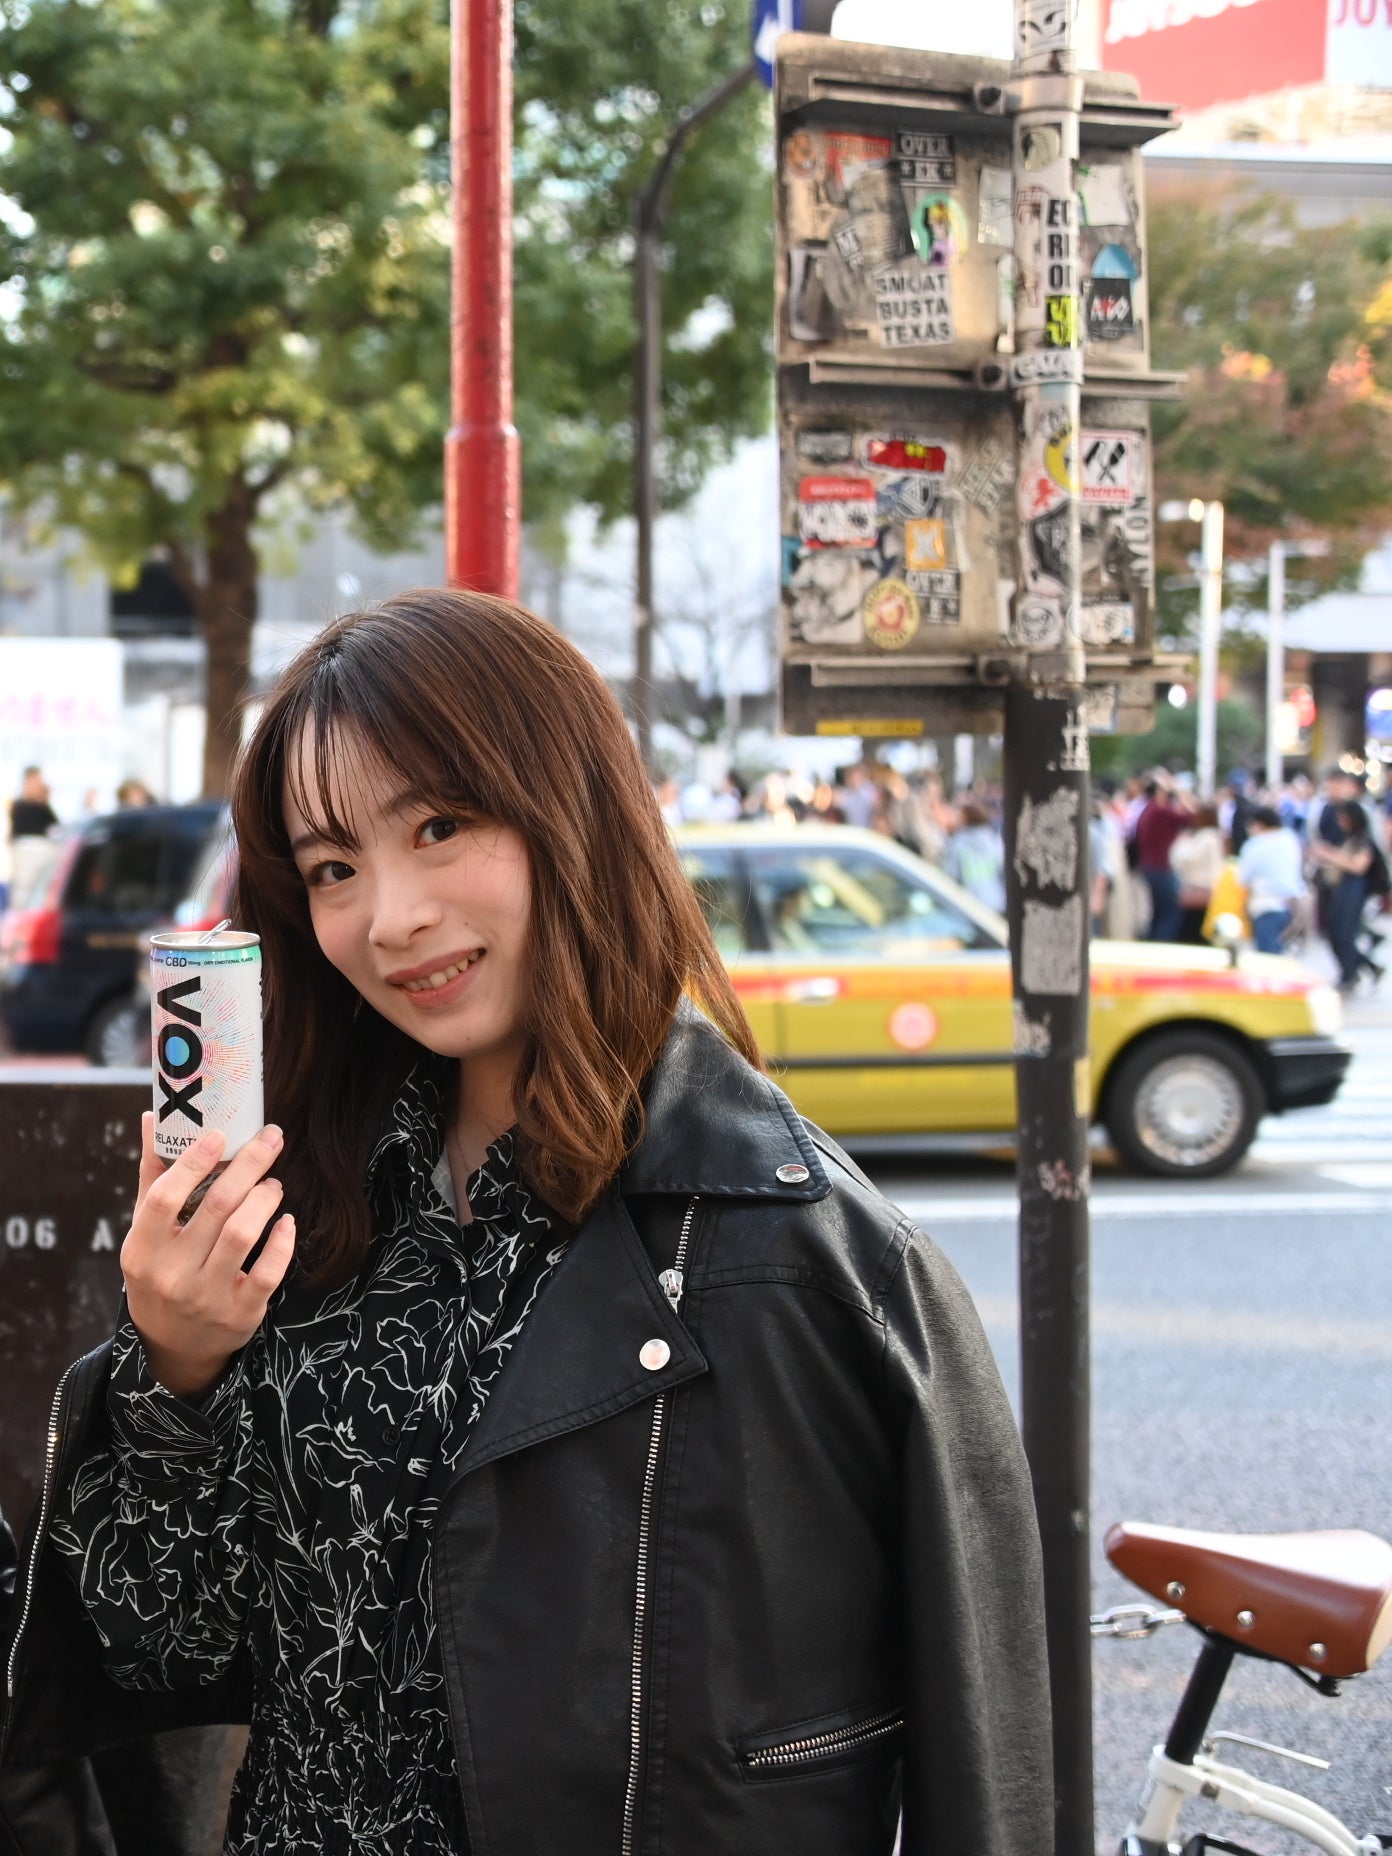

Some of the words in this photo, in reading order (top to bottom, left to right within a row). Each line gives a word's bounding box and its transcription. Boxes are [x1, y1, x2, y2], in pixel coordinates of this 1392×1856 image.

[878, 298, 948, 321] BUSTA
[880, 322, 950, 345] TEXAS
[165, 956, 187, 967] CBD
[156, 975, 204, 1128] VOX
[155, 1131, 197, 1148] RELAXAT
[92, 1219, 114, 1251] A
